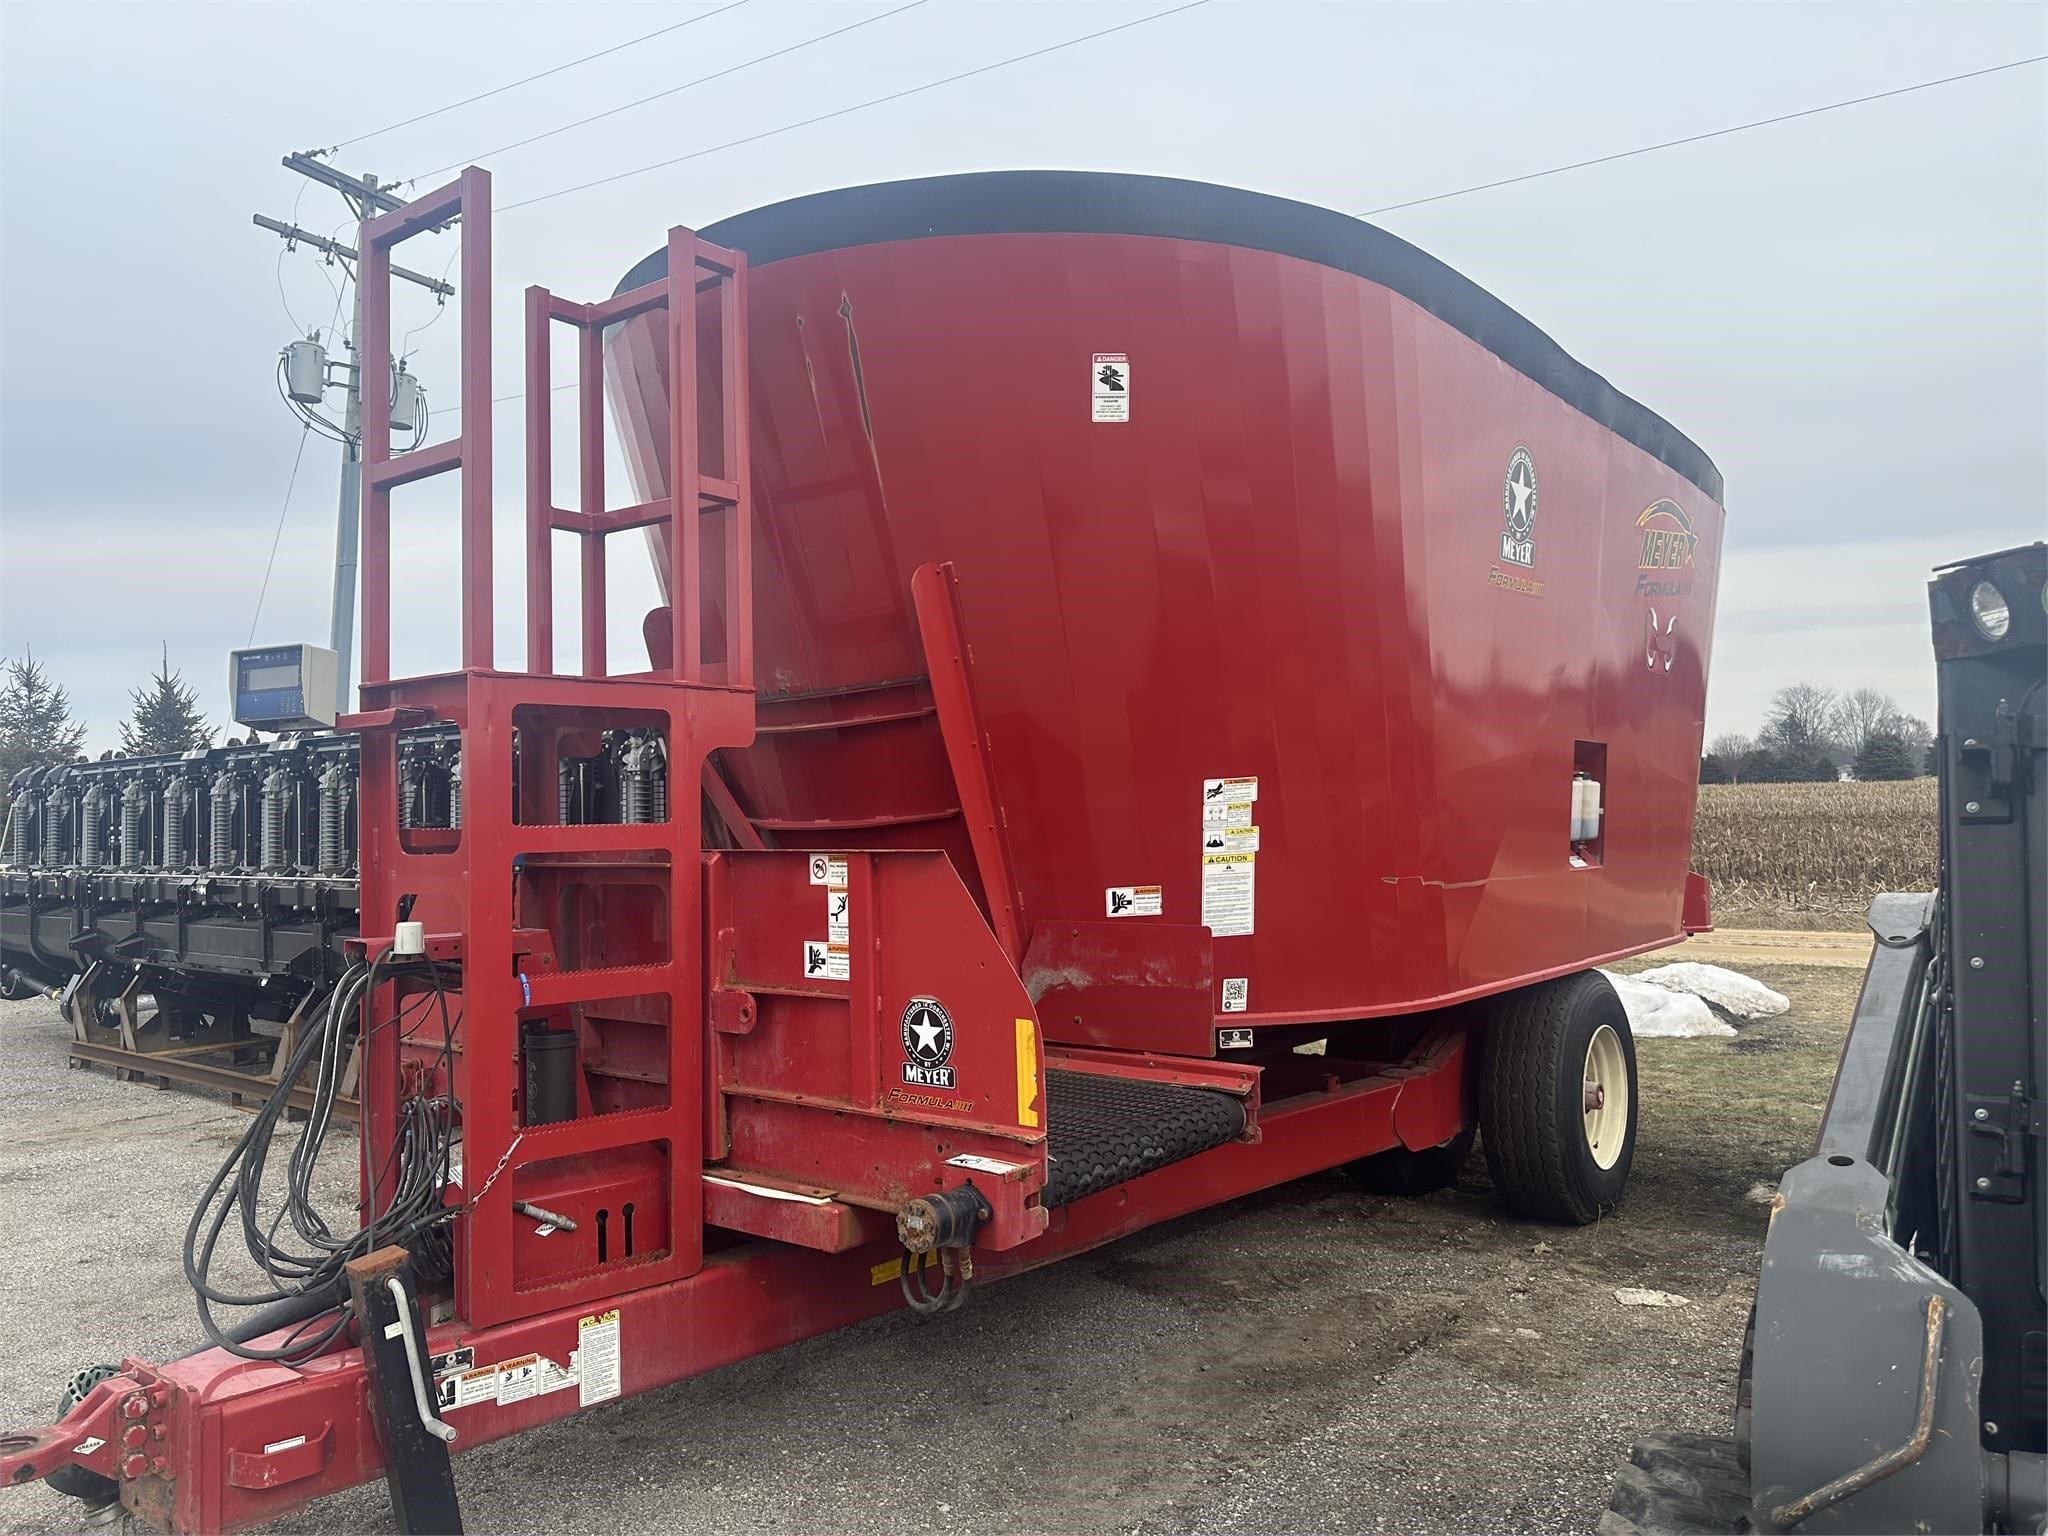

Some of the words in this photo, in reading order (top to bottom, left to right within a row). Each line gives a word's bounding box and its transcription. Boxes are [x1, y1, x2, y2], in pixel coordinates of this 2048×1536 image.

[1502, 535, 1531, 565] MEYER
[1638, 529, 1685, 569] MEYER
[1215, 855, 1248, 863] CAUTION
[902, 1002, 922, 1047] MANUFACTURED
[929, 1003, 952, 1041] DORCHESTER
[905, 1065, 950, 1086] MEYER
[506, 1356, 537, 1370] WARNING
[77, 1441, 100, 1450] GREASE
